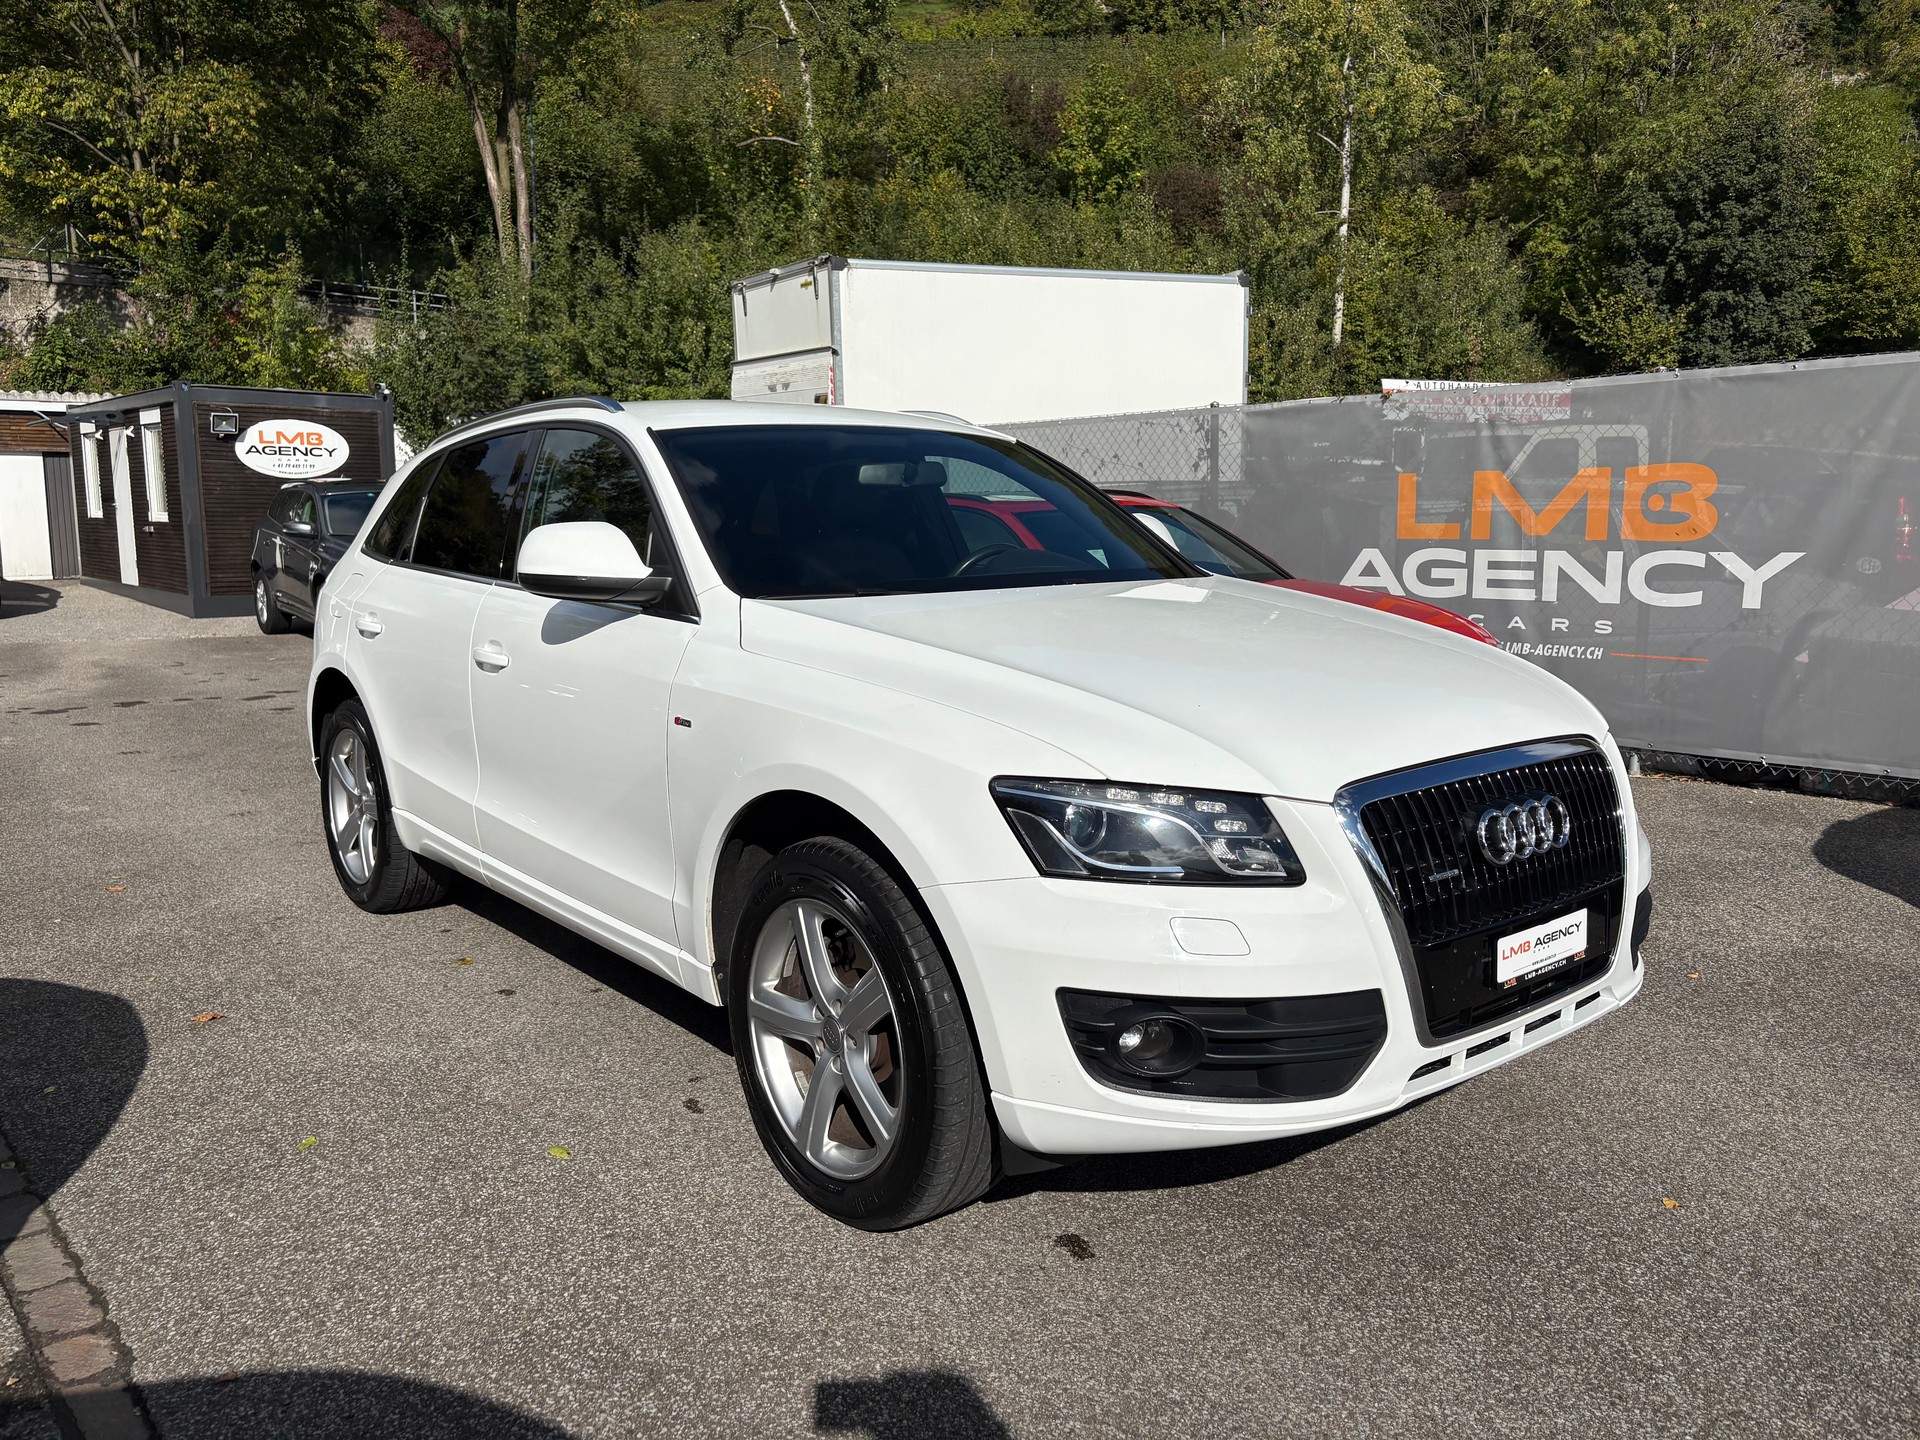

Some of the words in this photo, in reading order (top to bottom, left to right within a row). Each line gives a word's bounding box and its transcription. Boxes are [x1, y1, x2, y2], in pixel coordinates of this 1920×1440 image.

[258, 430, 323, 446] LMB
[245, 445, 338, 458] AGENCY
[1396, 462, 1718, 542] LMB
[1339, 548, 1807, 609] AGENCY
[1500, 641, 1604, 660] LMB-AGENCY.CH
[1502, 940, 1531, 960] LMB
[1533, 921, 1582, 948] AGENCY
[1524, 959, 1567, 980] LMB-AGENCY.CH
